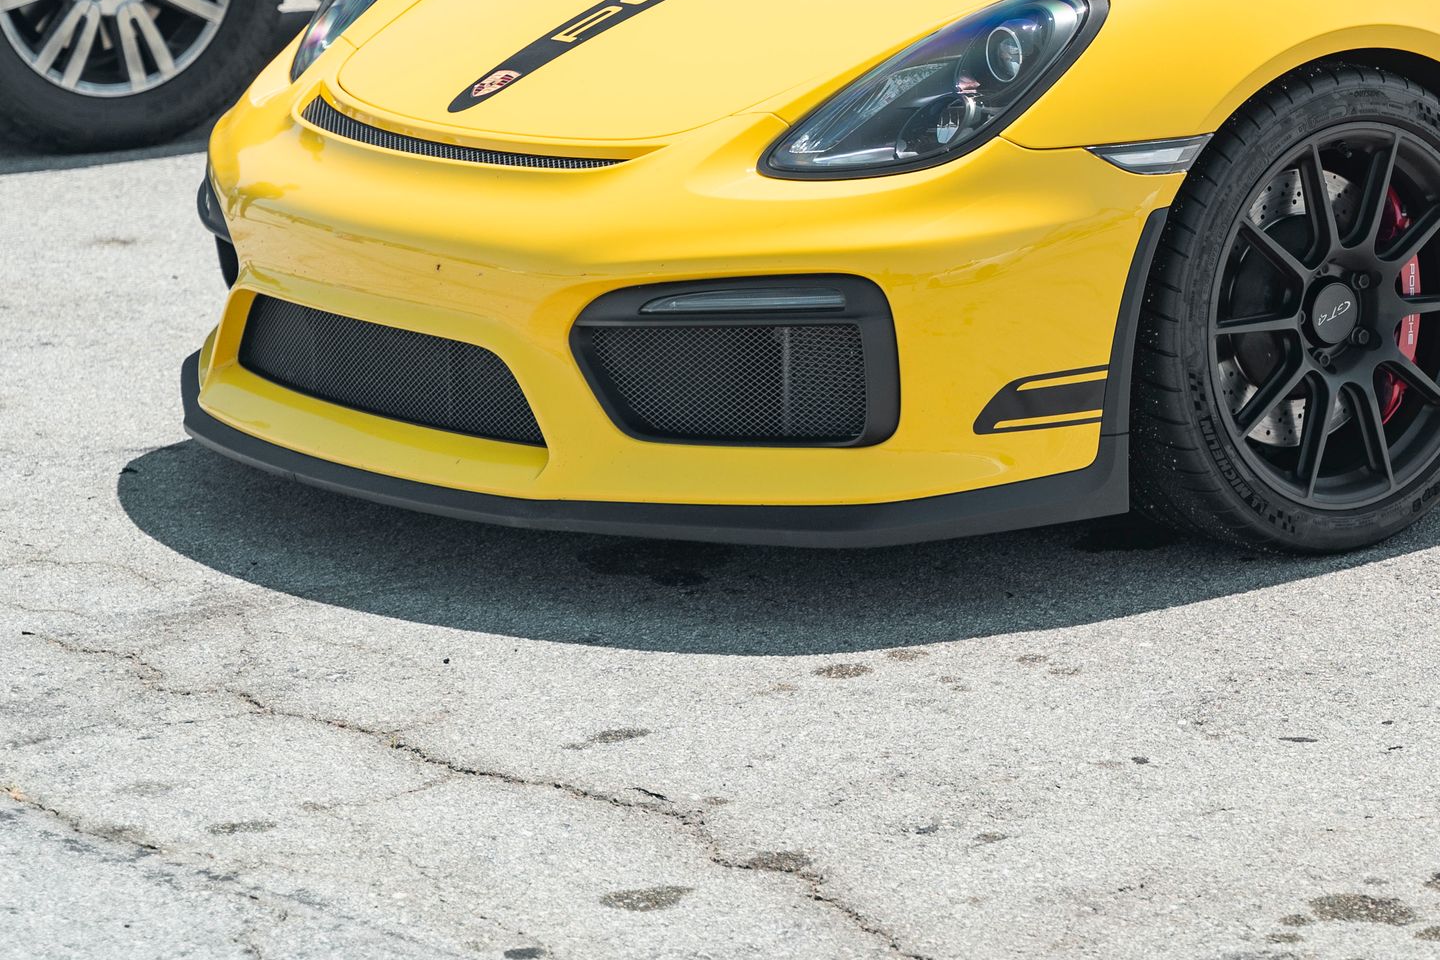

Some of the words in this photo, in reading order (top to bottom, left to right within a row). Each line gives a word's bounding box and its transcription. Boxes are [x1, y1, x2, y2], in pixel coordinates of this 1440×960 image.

[1318, 301, 1351, 327] GT4
[1407, 263, 1416, 345] PORCHE
[1200, 419, 1253, 500] MICHELIN
